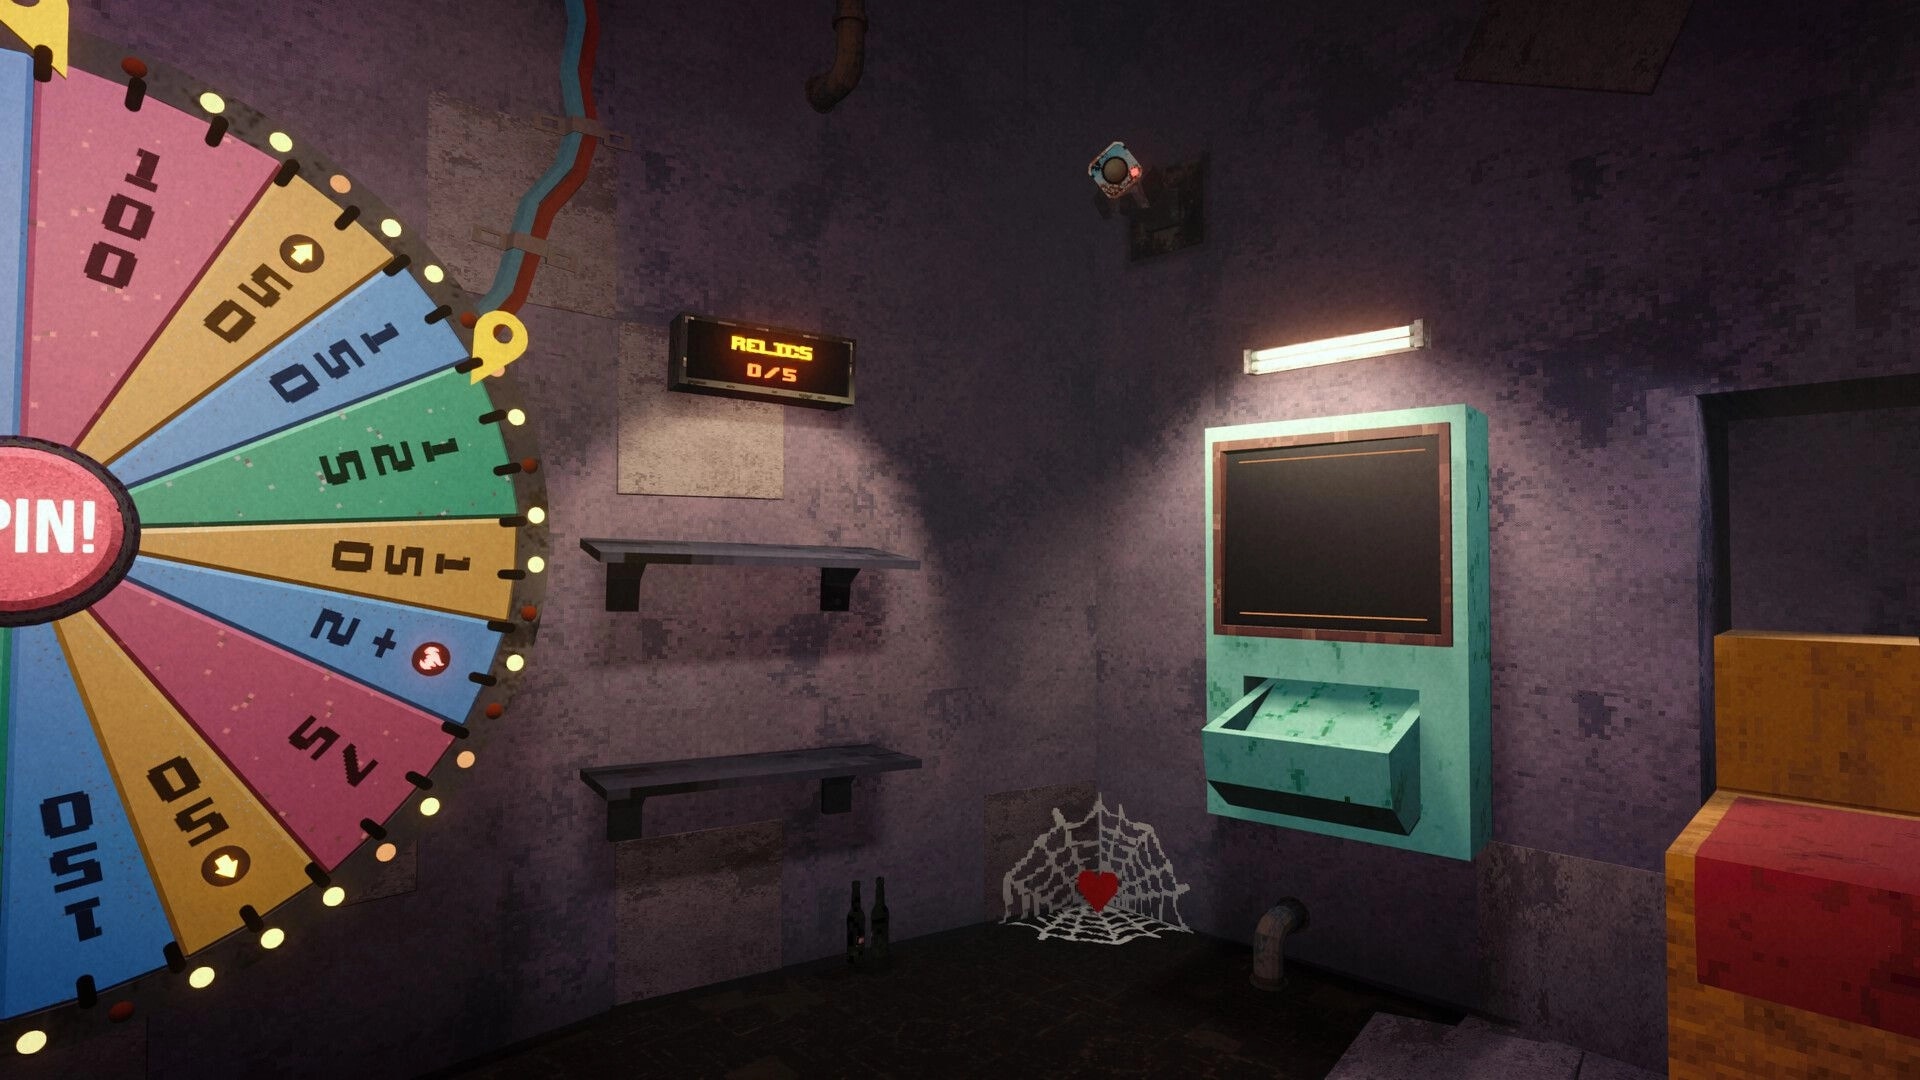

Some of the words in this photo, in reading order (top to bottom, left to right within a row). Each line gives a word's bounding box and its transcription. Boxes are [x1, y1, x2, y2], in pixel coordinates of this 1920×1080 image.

[84, 148, 160, 289] 100
[204, 264, 293, 343] 50
[269, 323, 399, 402] 150
[731, 335, 813, 361] RELICS
[747, 363, 797, 382] 0/5
[319, 438, 459, 486] 125
[331, 541, 471, 577] 150
[288, 715, 378, 788] 75
[146, 756, 230, 848] 50
[39, 791, 103, 942] 150
